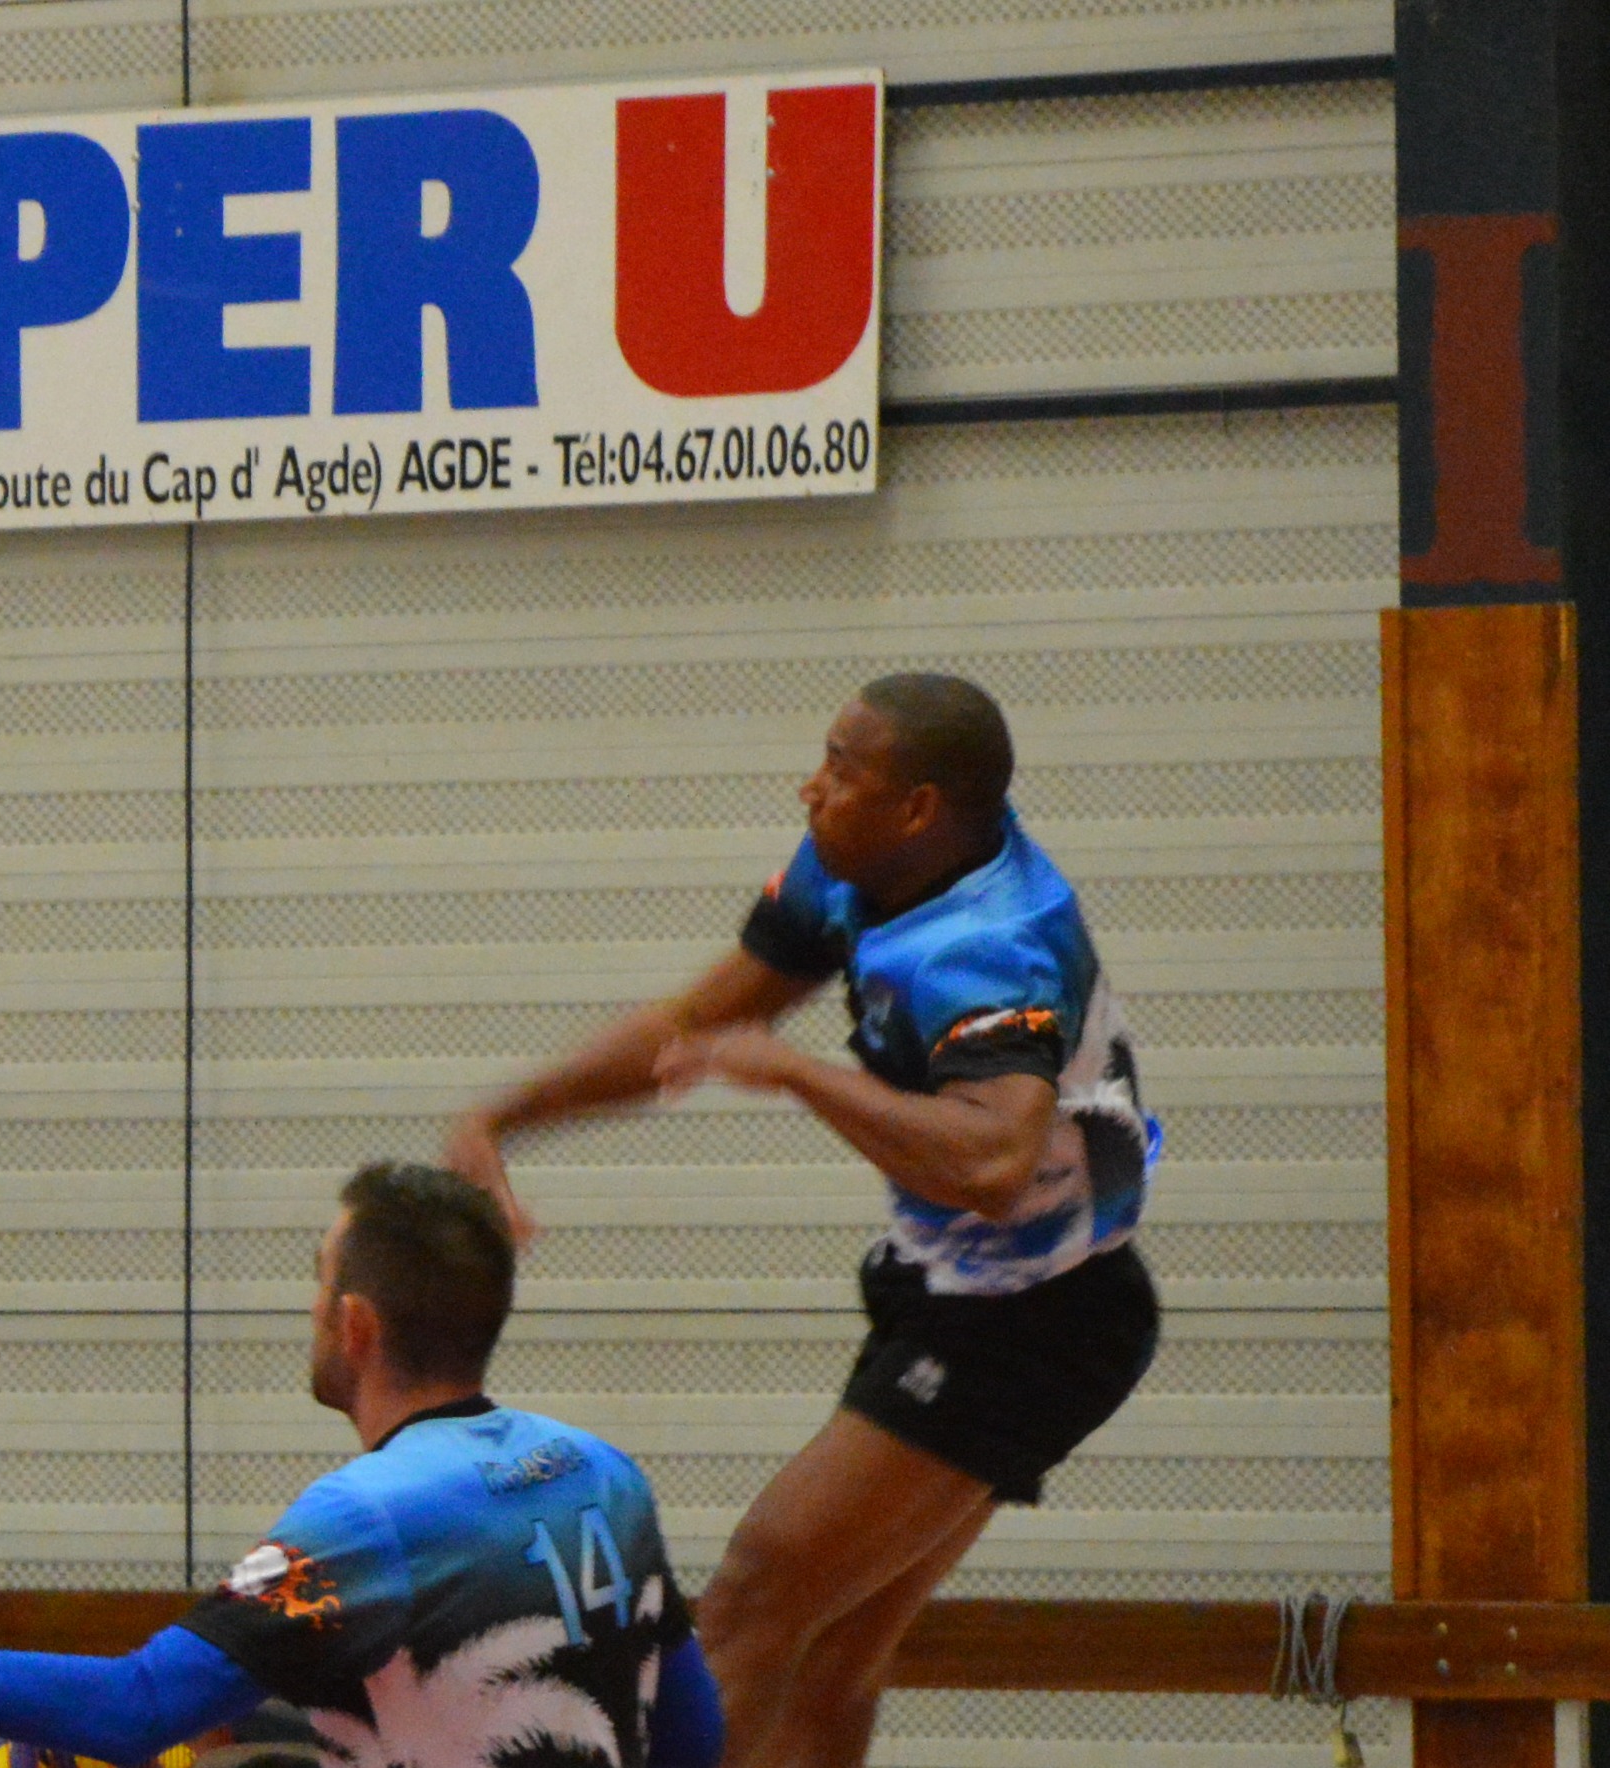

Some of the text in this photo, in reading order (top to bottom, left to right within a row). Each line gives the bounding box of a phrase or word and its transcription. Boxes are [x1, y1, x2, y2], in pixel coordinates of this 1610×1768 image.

[615, 83, 877, 398] U
[84, 453, 131, 507] du
[142, 450, 217, 518] Cap
[230, 446, 260, 500] d'
[273, 440, 383, 511] Agde)
[396, 435, 513, 494] AGDE
[524, 1505, 633, 1646] 14
